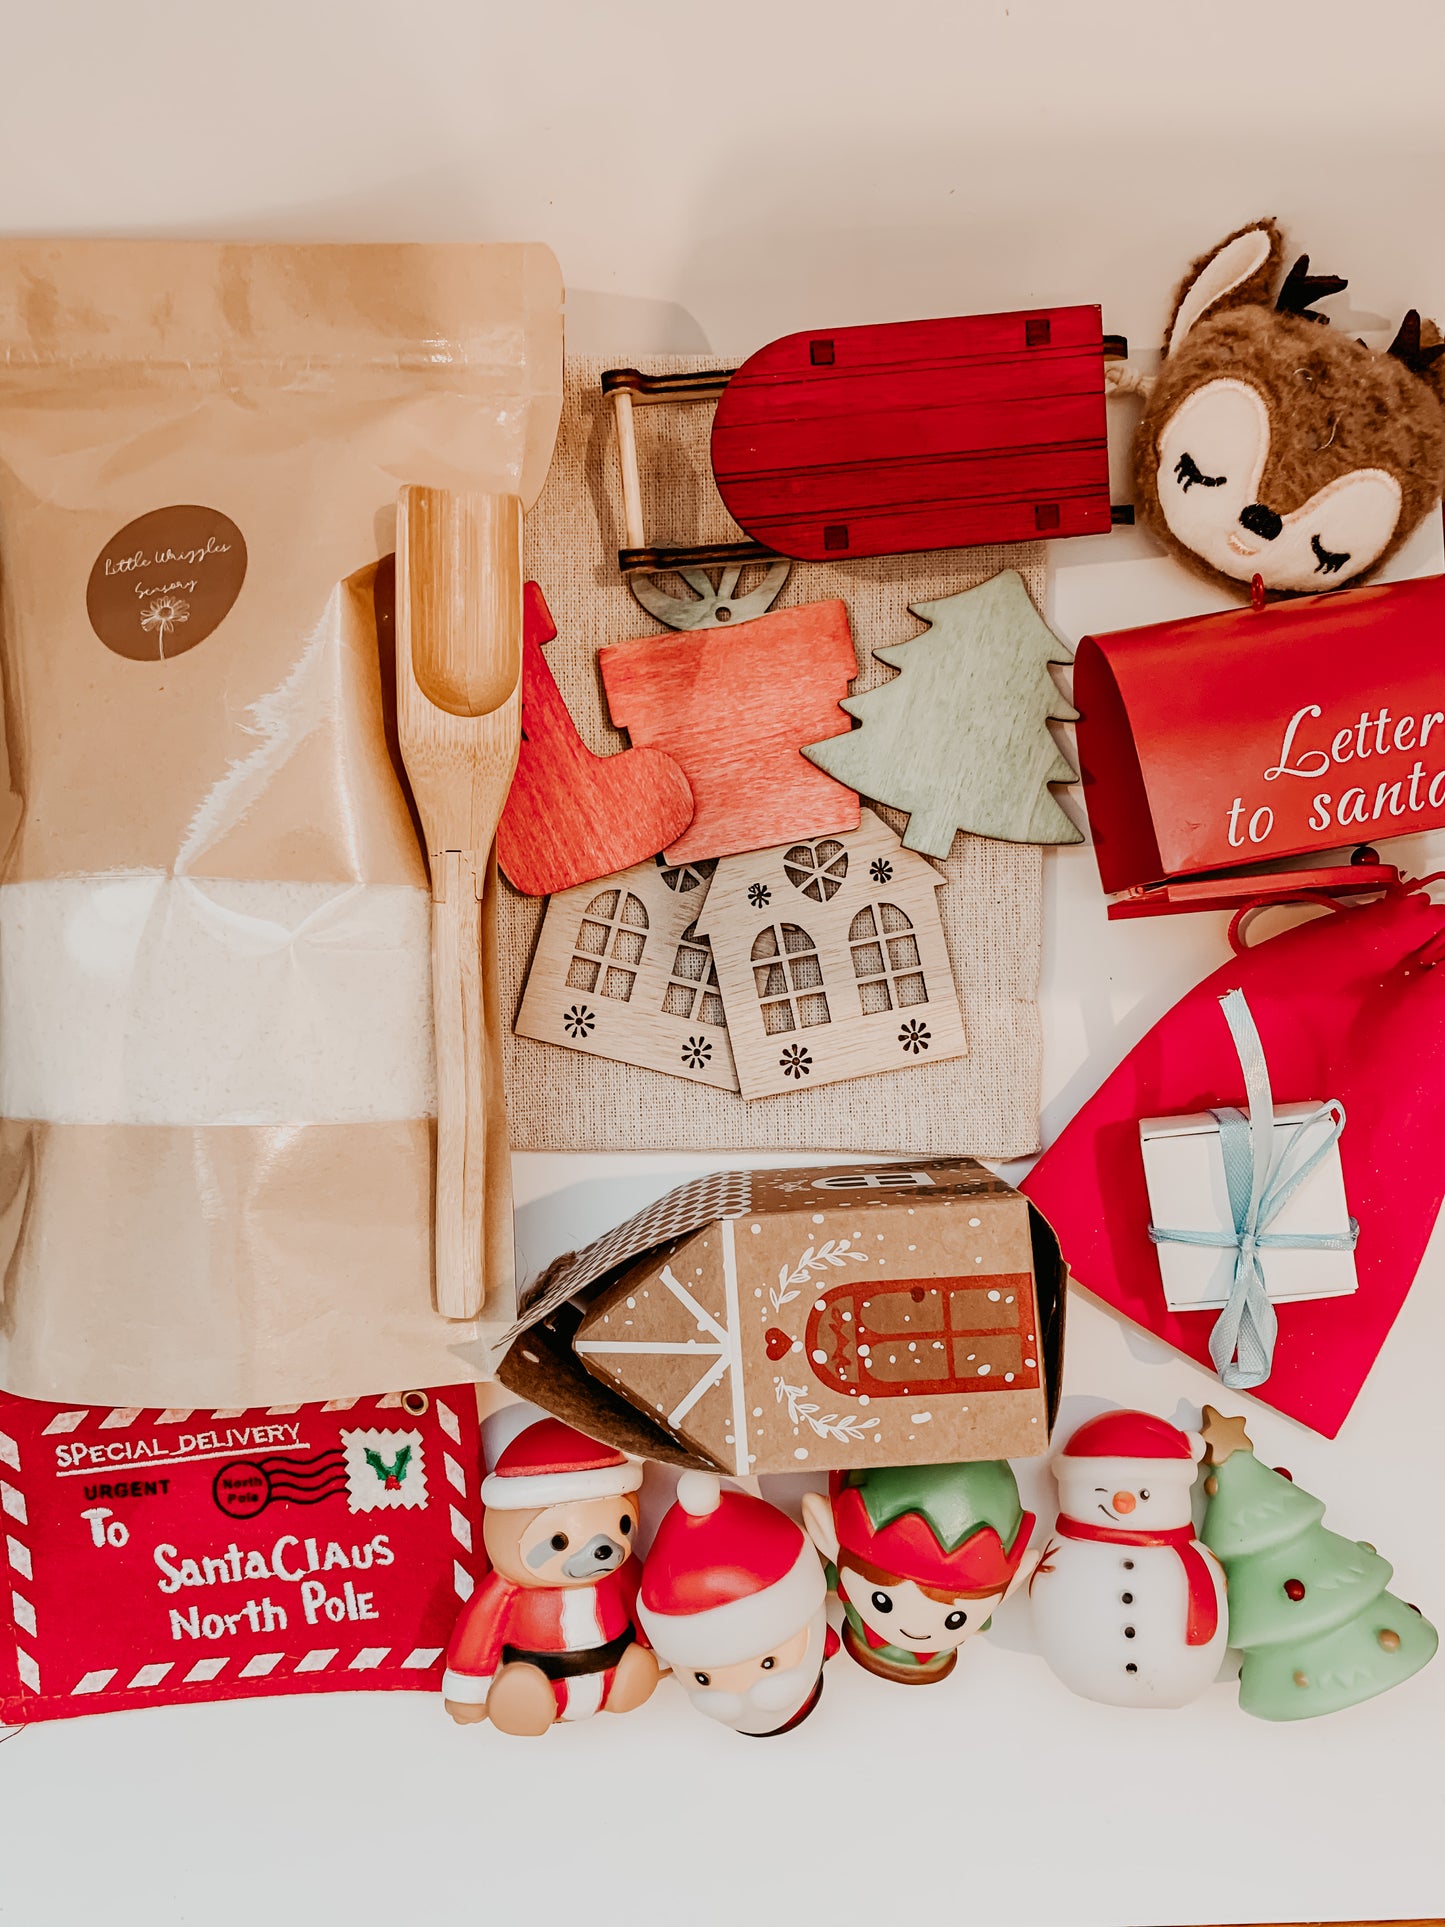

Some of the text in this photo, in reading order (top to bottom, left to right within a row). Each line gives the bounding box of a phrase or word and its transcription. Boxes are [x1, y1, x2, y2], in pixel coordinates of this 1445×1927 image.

[105, 551, 151, 576] Little
[135, 580, 197, 598] Sensory
[1263, 704, 1445, 781] Letter
[1226, 797, 1274, 847] to
[56, 1423, 300, 1468] SPECIAL DELIVERY
[84, 1479, 171, 1500] URGENT
[222, 1477, 263, 1490] North
[227, 1491, 259, 1504] Pole
[80, 1507, 130, 1547] To
[153, 1542, 275, 1594] Santa
[169, 1597, 287, 1640] North
